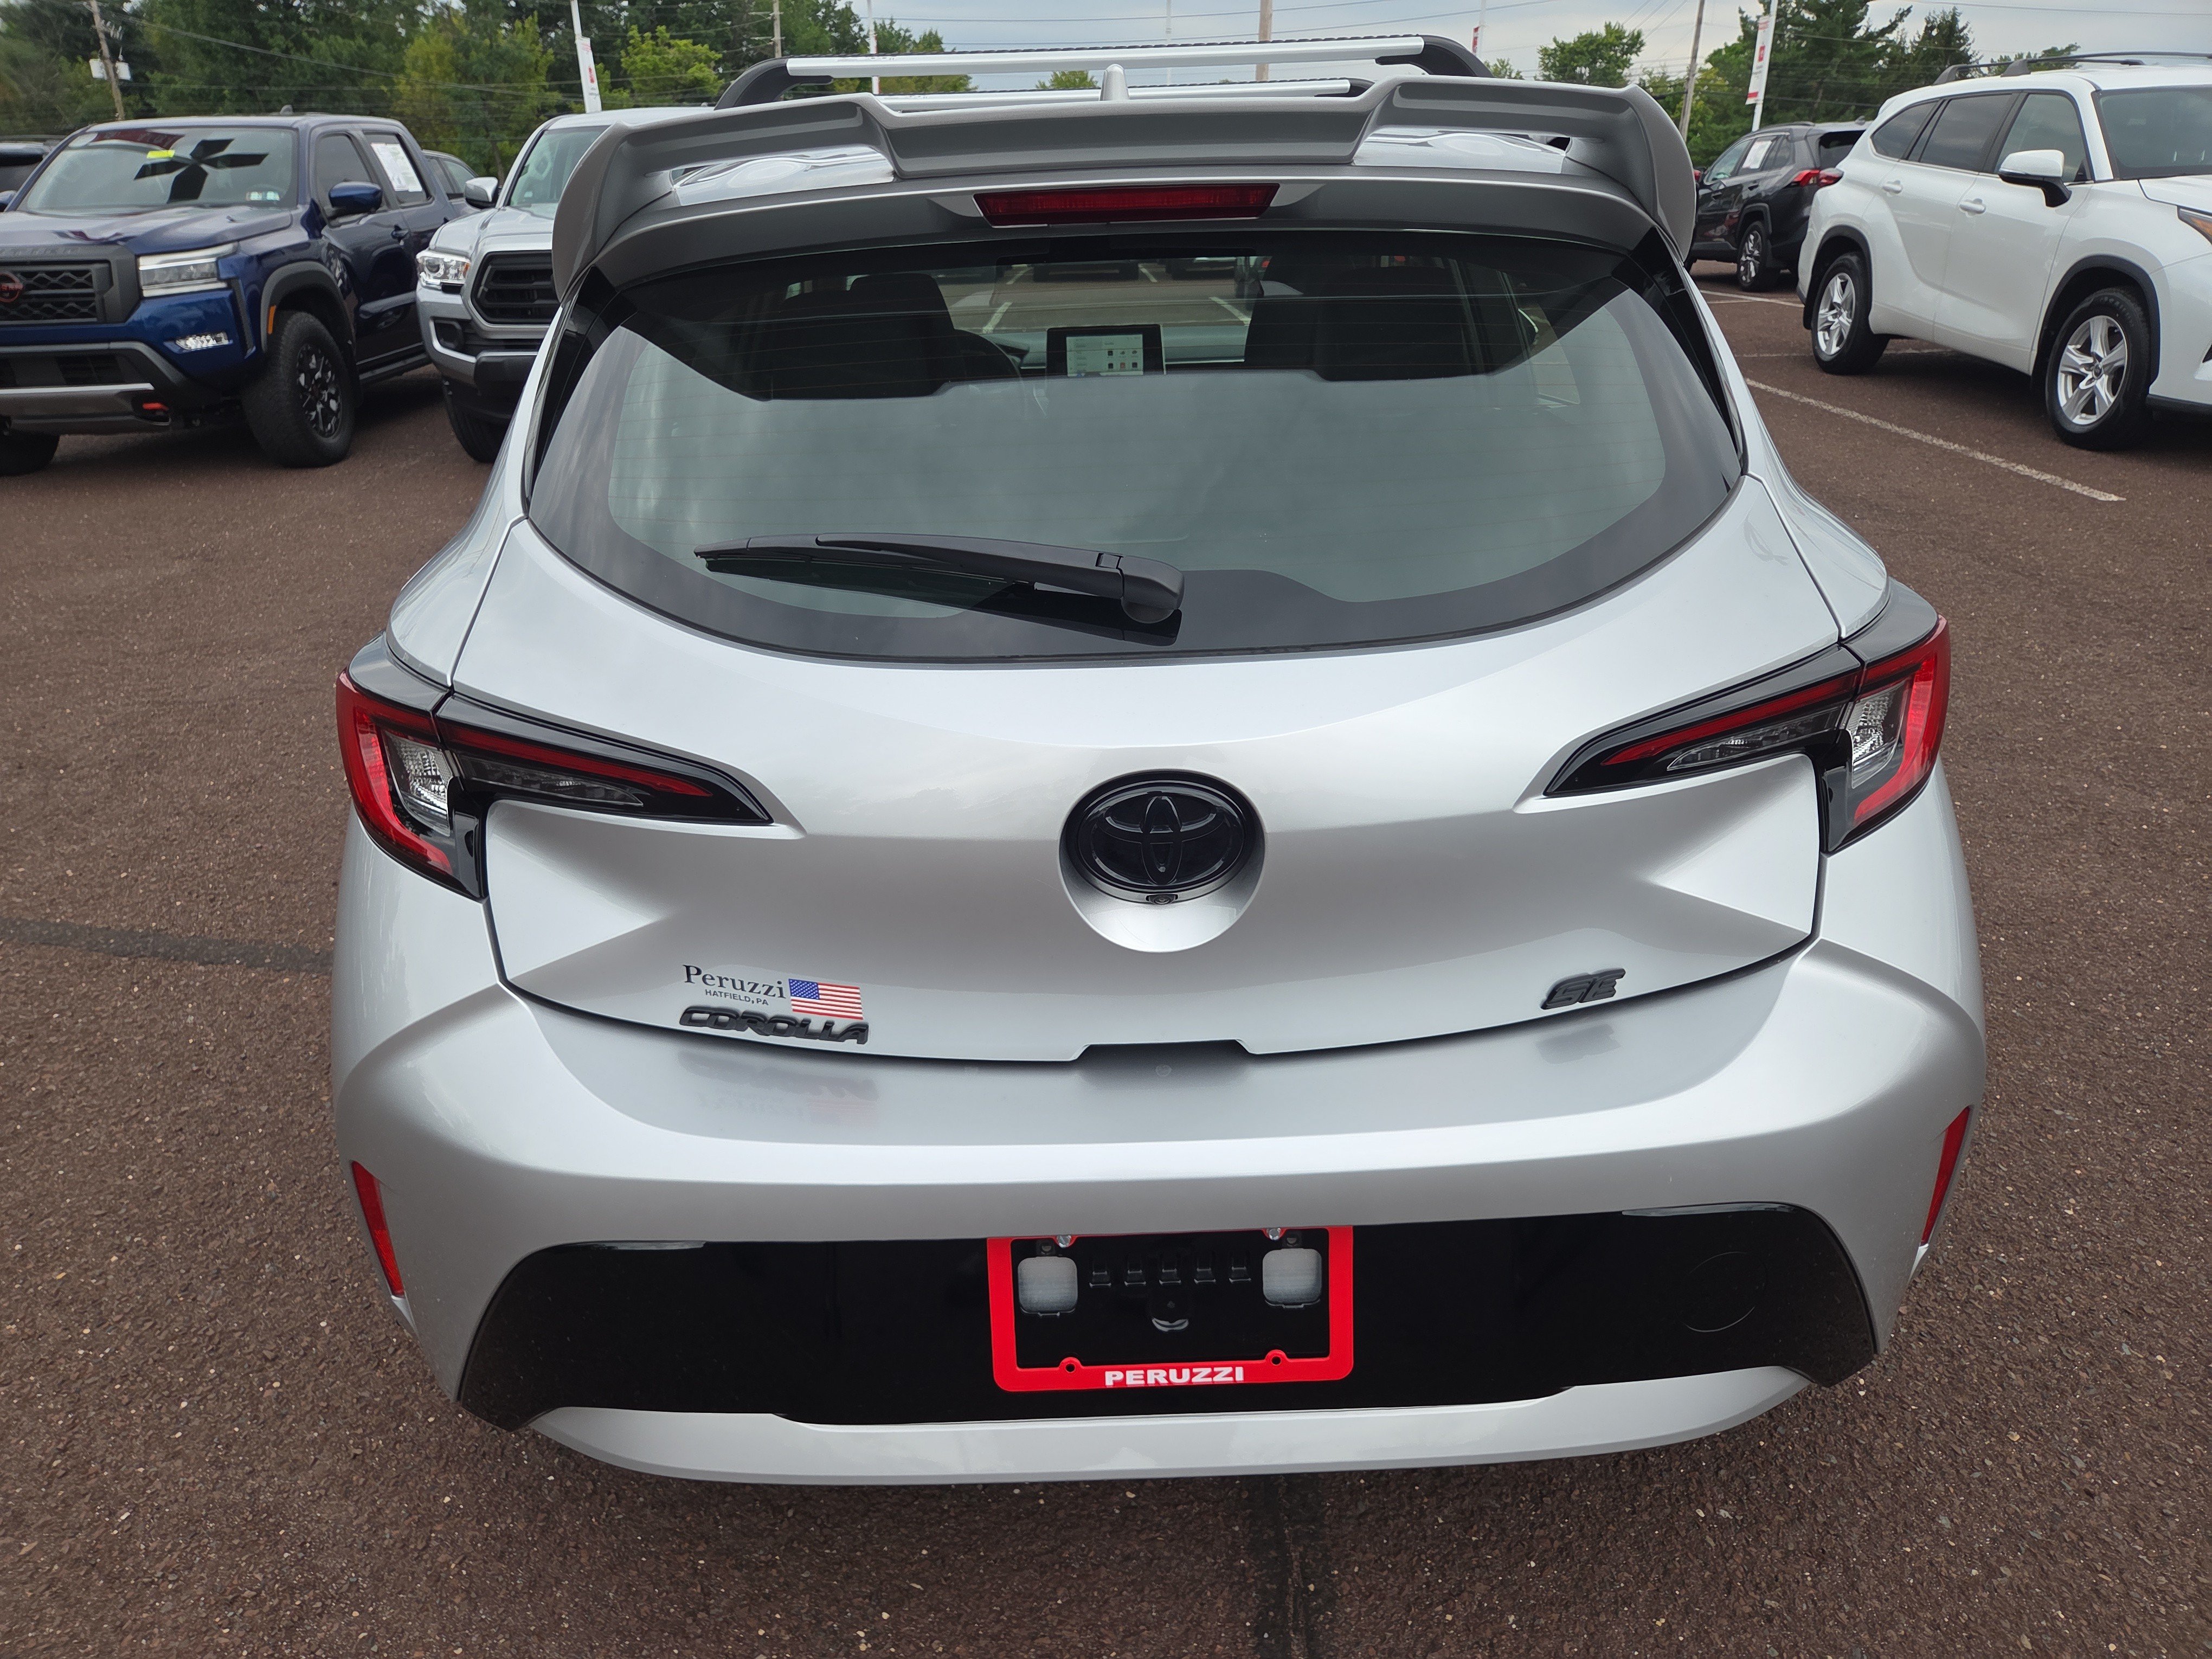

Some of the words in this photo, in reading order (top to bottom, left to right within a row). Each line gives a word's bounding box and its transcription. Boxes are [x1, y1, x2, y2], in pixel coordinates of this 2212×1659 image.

[682, 964, 786, 999] Peruzzi
[679, 1005, 869, 1044] COROLLA
[1105, 1366, 1244, 1386] PERUZZI
